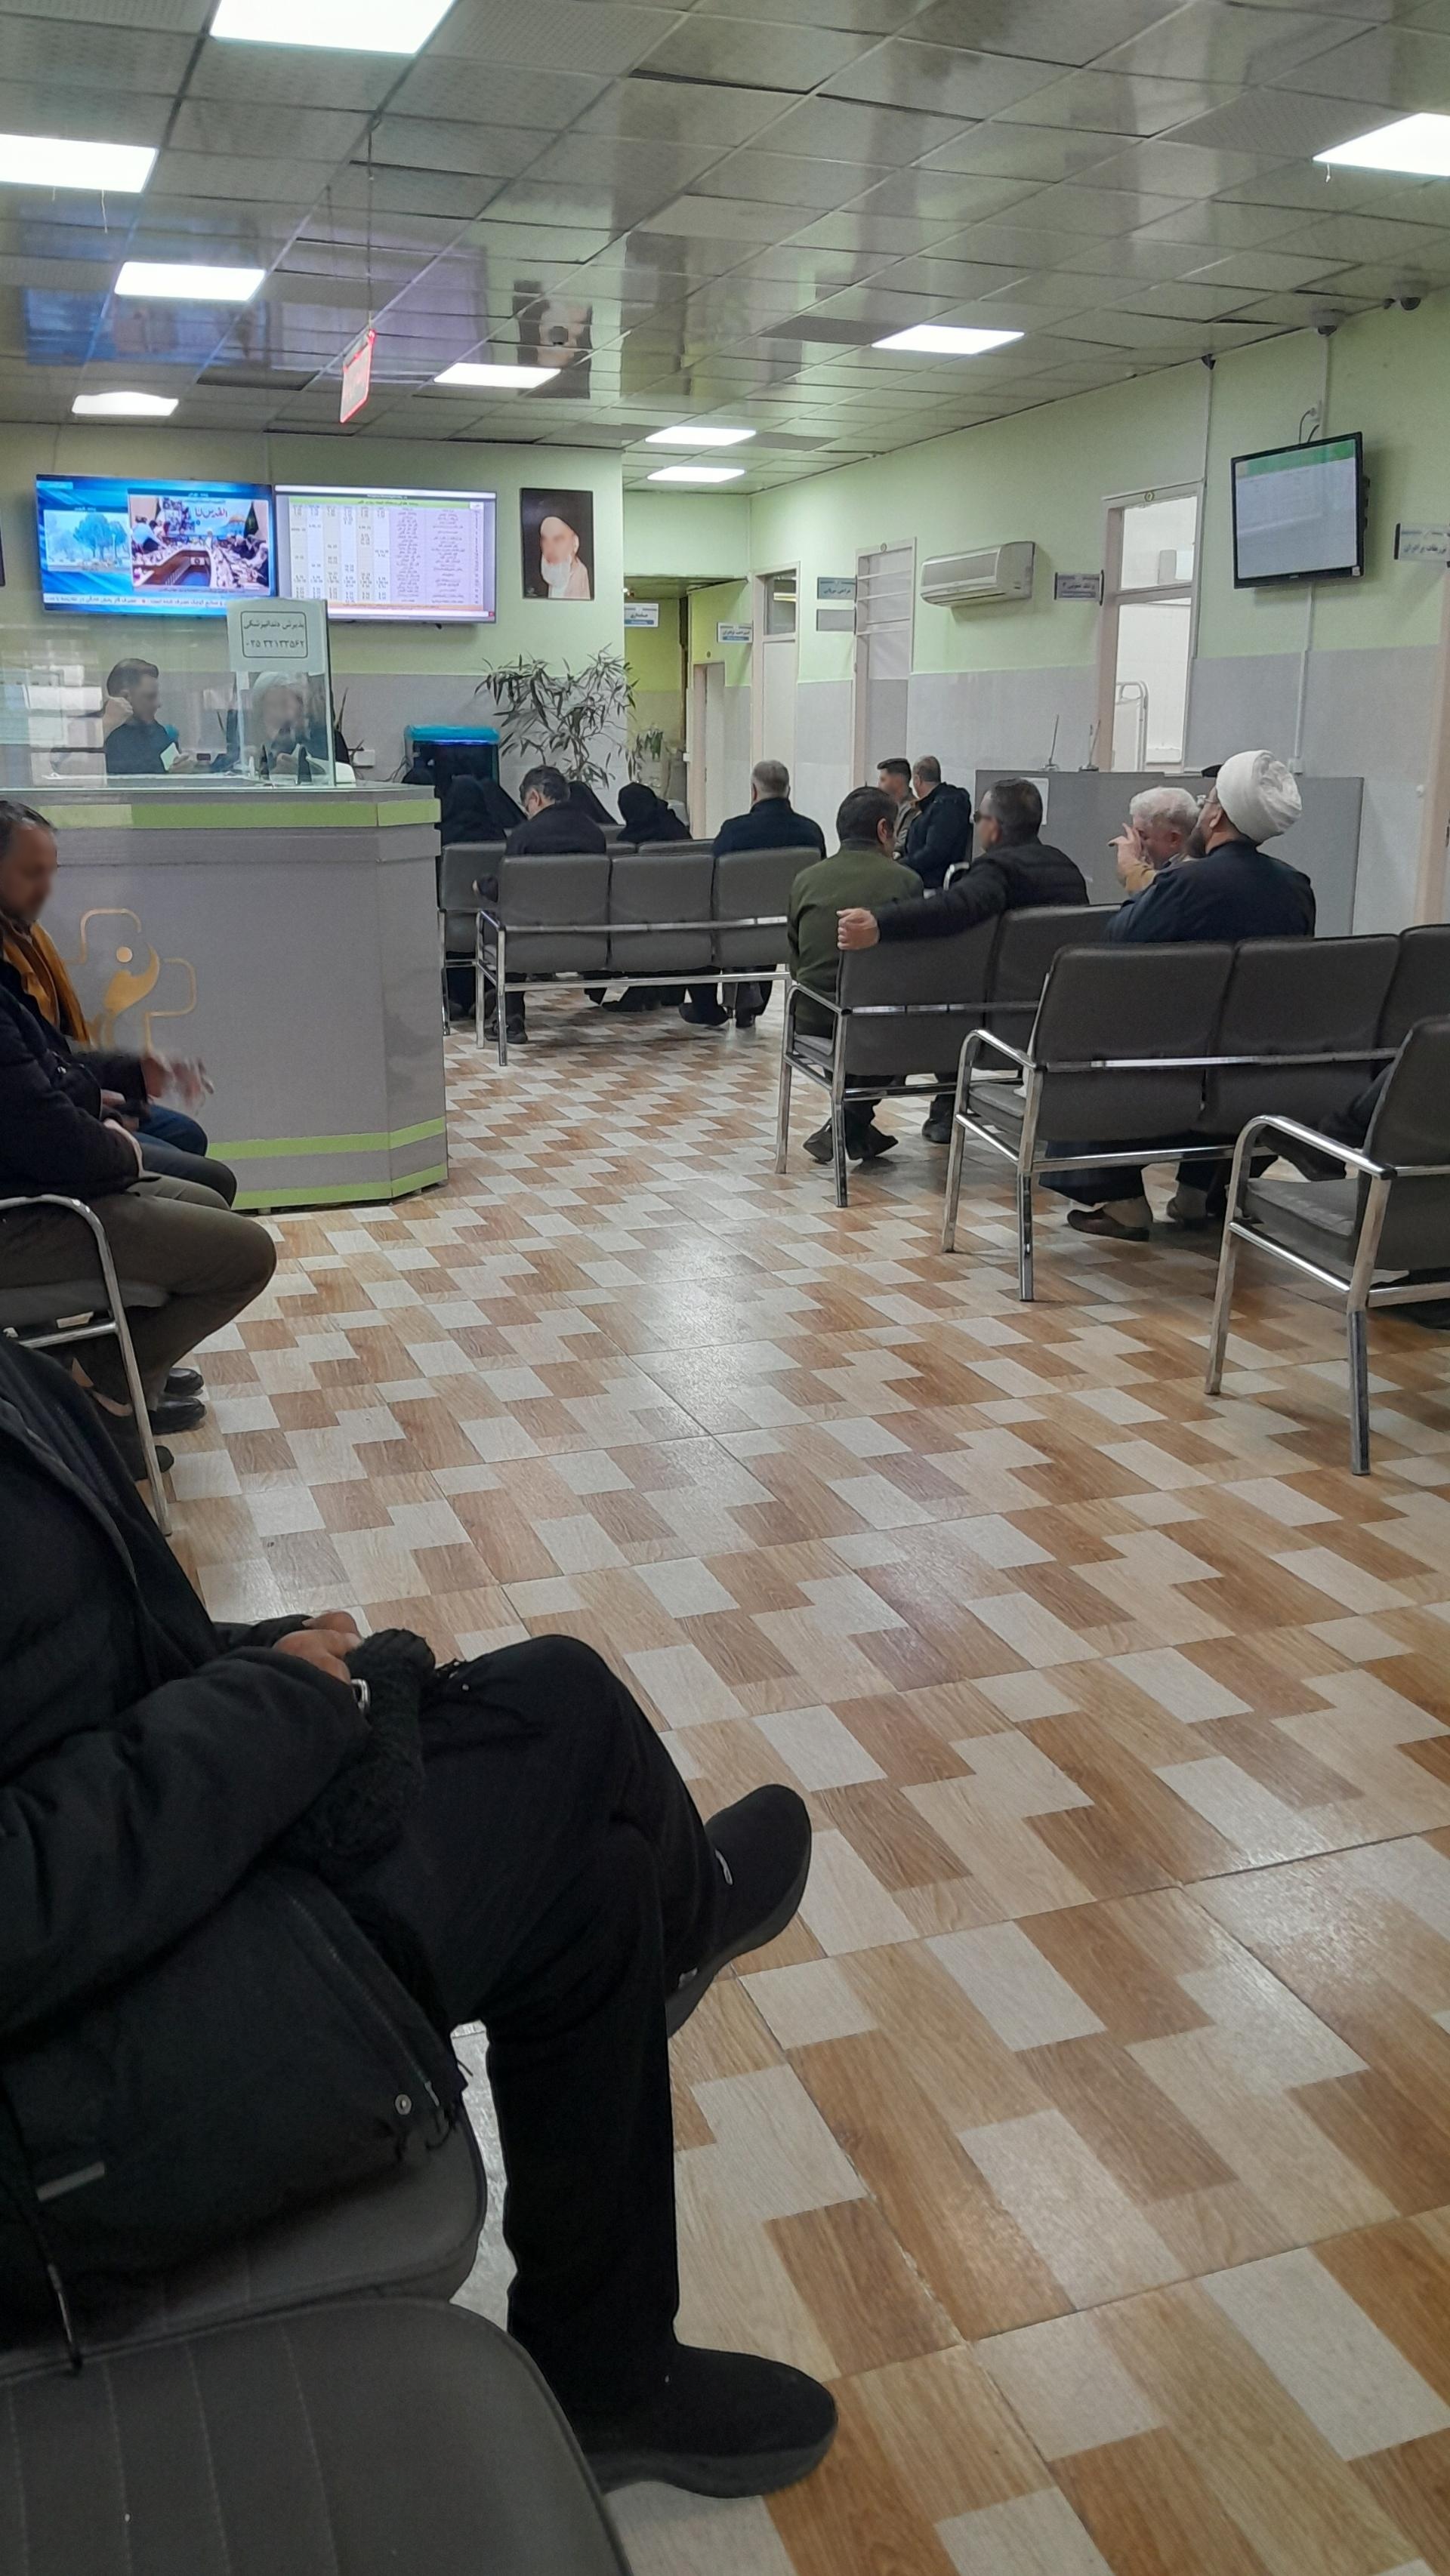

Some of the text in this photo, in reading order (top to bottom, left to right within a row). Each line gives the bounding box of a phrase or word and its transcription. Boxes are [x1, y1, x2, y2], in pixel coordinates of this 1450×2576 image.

[243, 619, 304, 630] پذیرش دندانپزشکی
[246, 639, 261, 648] ۰۲۵
